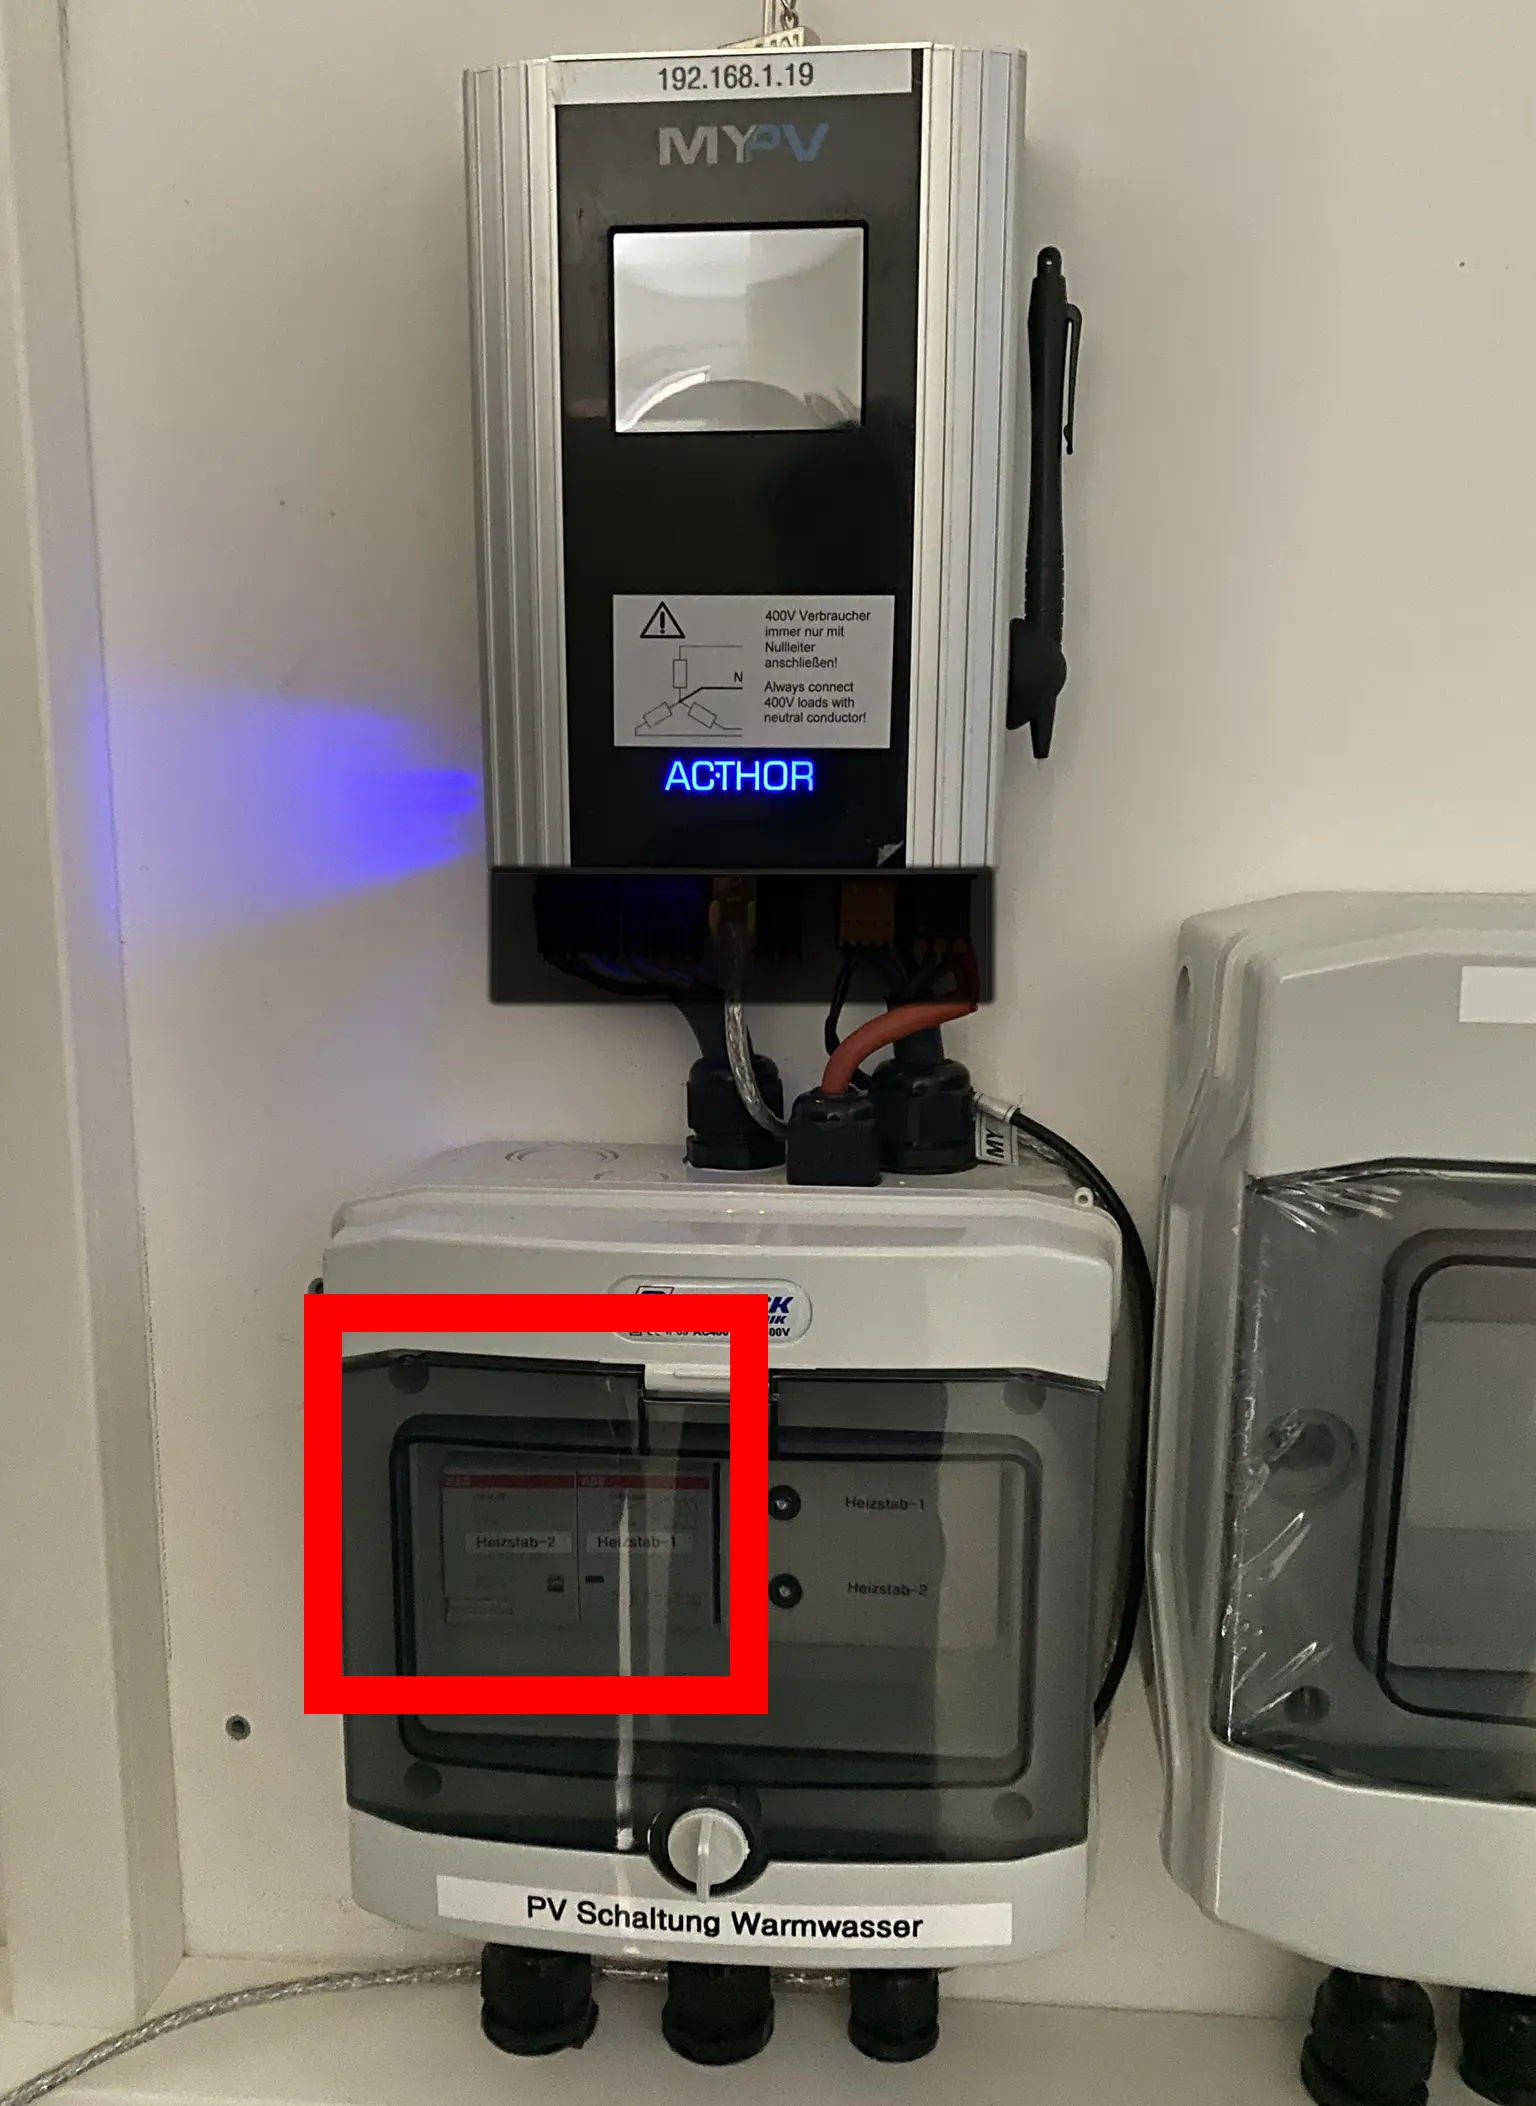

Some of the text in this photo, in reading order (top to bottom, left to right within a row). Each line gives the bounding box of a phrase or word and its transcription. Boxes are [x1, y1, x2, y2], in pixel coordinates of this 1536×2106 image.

[658, 62, 814, 90] 192.168.1.19
[659, 123, 830, 165] MYPV
[765, 610, 871, 622] 400V Verbraucher
[765, 625, 845, 637] immer nur mit
[765, 641, 816, 653] Nullleiter
[765, 656, 838, 669] anschließen!
[734, 671, 744, 683] N
[764, 681, 854, 695] Always connect
[764, 696, 855, 708] 400V loads with
[764, 711, 867, 723] neutral conductor!
[845, 1496, 926, 1512] Heizstab-1
[476, 1536, 556, 1549] Heizstab-2
[597, 1536, 676, 1549] Heizstab-1
[847, 1580, 929, 1597] Heizstab-2
[527, 1895, 924, 1939] PV Schaltung Warmwasser
